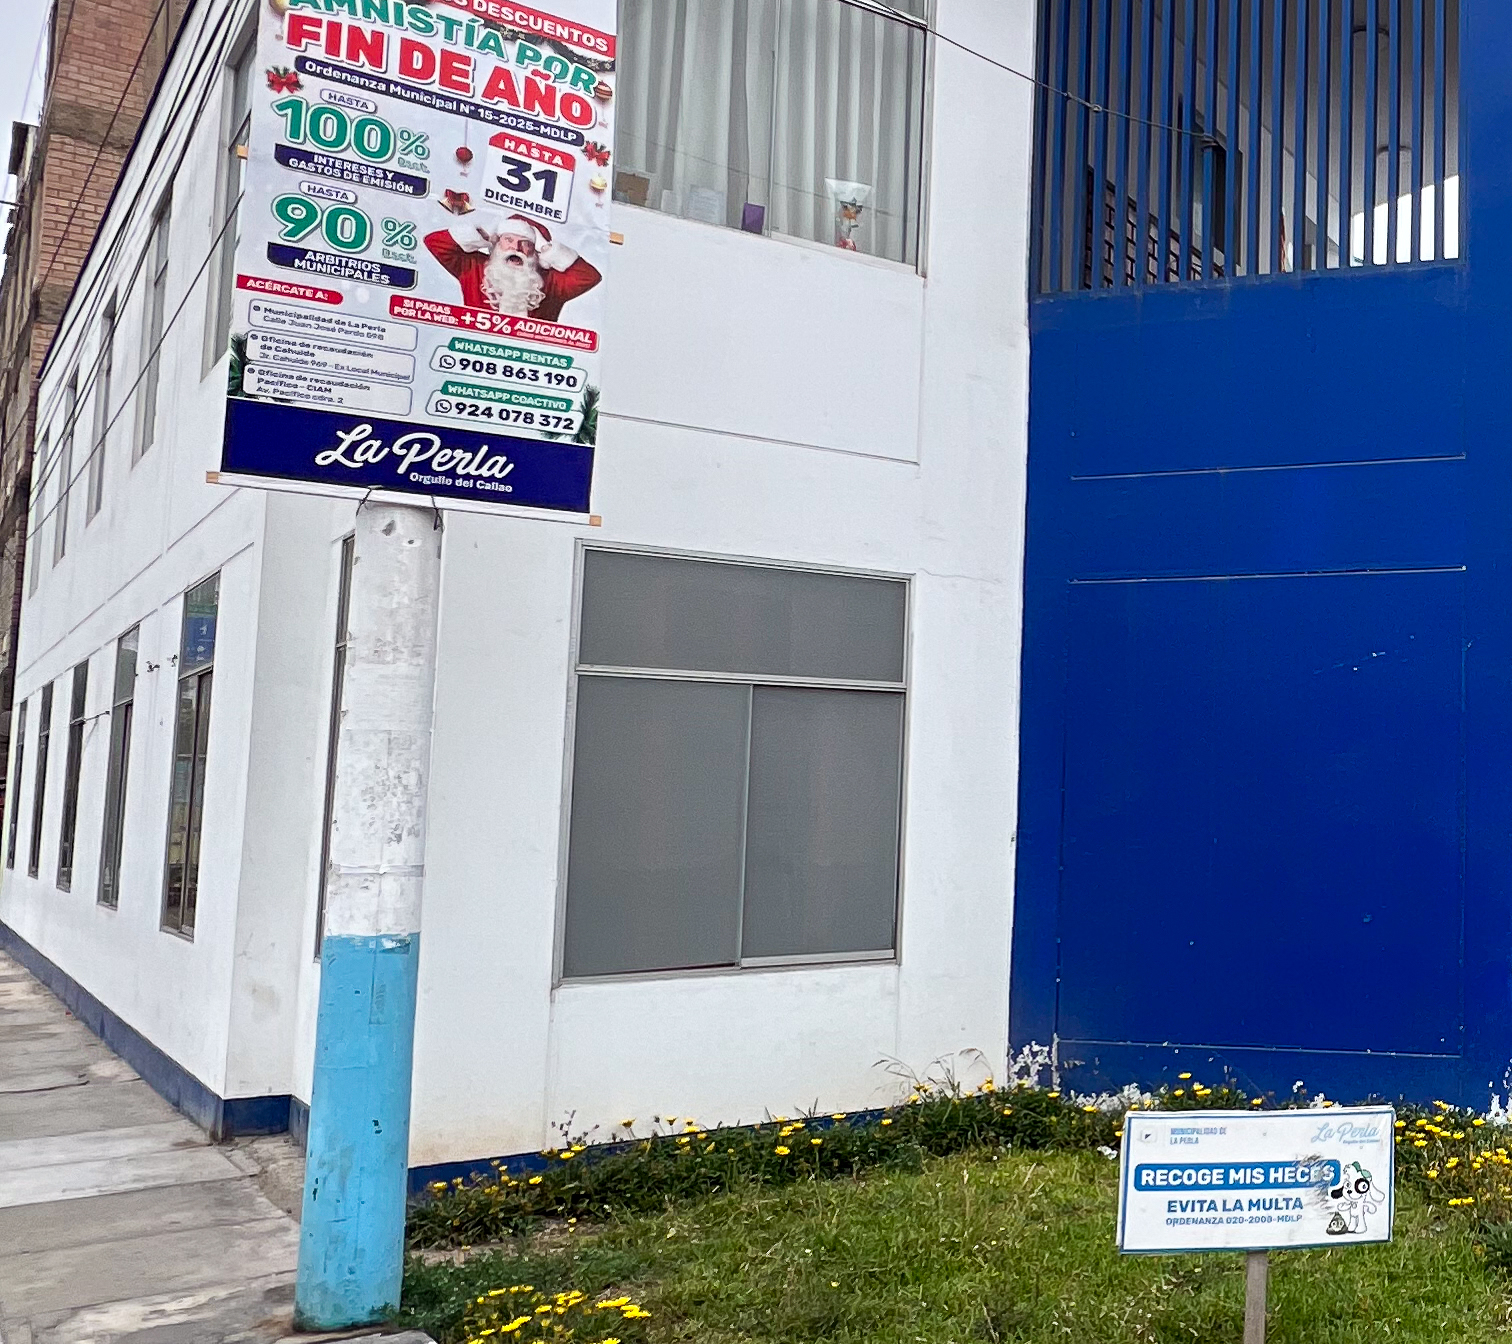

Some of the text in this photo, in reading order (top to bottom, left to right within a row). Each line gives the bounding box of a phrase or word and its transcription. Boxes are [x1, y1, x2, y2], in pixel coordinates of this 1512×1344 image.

[286, 12, 594, 127] FIN DE AÑO
[515, 40, 598, 96] POR
[304, 60, 386, 91] Ordenanza
[389, 83, 457, 110] Municipal
[478, 109, 577, 142] 15-2025-MDLP
[327, 92, 370, 110] HASTA
[503, 139, 564, 166] HASTA
[288, 158, 414, 194] GASTOS DE EMISIÓN
[313, 155, 395, 180] INTERESES Y
[496, 155, 558, 203] 31
[307, 185, 349, 200] HASTA
[485, 188, 563, 220] DICIEMBRE
[294, 259, 391, 285] MUNICIPALES
[304, 251, 381, 273] ARBITRIOS
[246, 278, 314, 298] ACÉRCATE
[263, 307, 333, 326] Municipalidad
[393, 306, 416, 318] POR
[417, 310, 432, 320] LA
[419, 301, 451, 315] PAGAS
[460, 311, 512, 335] +5%
[514, 320, 593, 344] ADICIONAL
[454, 340, 521, 359] WHATSAPP
[523, 352, 568, 368] RENTAS
[458, 358, 578, 388] 908 863 190
[447, 384, 567, 410] WHATSAPP COACTIVO
[454, 401, 575, 431] 924 078 372
[315, 423, 515, 479] La Perla
[409, 472, 513, 493] Orgullo del Callao
[1170, 1137, 1178, 1145] LA
[1310, 1121, 1380, 1143] La Perla
[1141, 1168, 1225, 1186] RECOGE
[1228, 1167, 1265, 1185] MIS
[1167, 1197, 1304, 1213] EVITA LA MULTA
[1165, 1217, 1224, 1227] ORDENANZA
